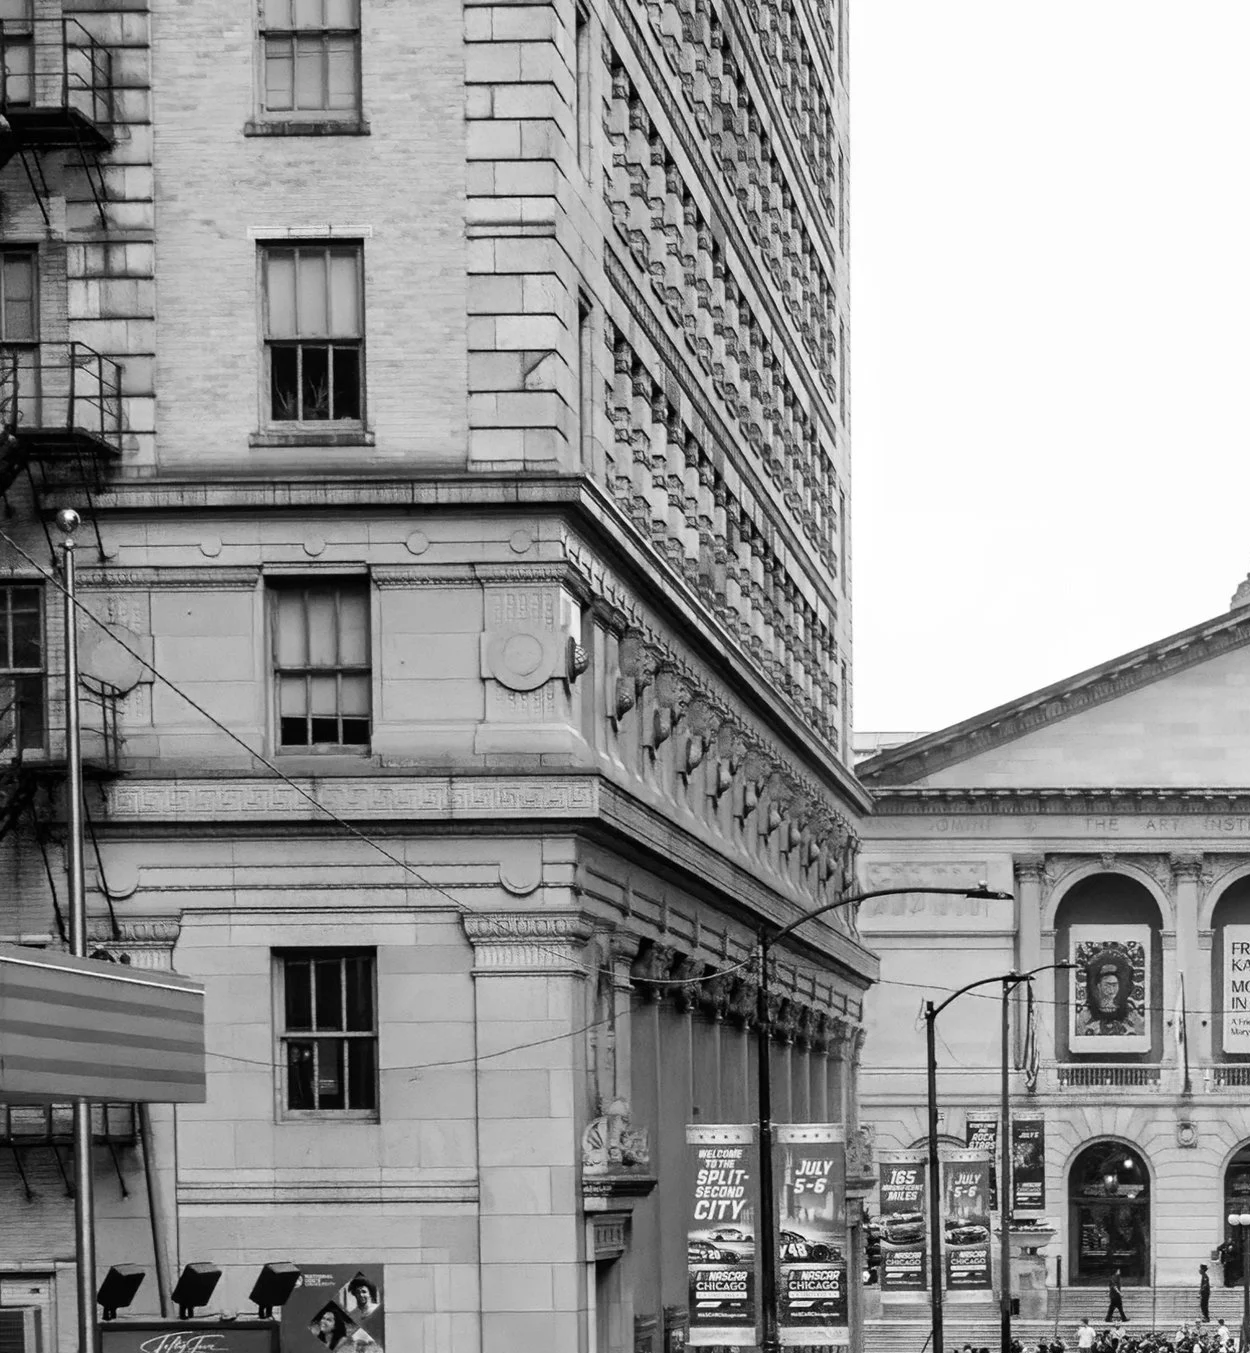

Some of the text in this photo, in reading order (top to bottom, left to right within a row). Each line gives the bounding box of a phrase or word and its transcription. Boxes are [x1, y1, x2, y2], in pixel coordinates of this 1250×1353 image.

[1085, 818, 1119, 831] THE
[1146, 818, 1179, 831] ART
[1232, 997, 1247, 1009] IN
[795, 1160, 833, 1176] JULY
[697, 1169, 749, 1185] SPLIT-
[695, 1186, 744, 1198] SECOND
[794, 1178, 827, 1194] 5-6
[693, 1200, 747, 1220] CITY
[696, 1281, 747, 1291] CHICAGO
[789, 1281, 839, 1290] CHICAGO
